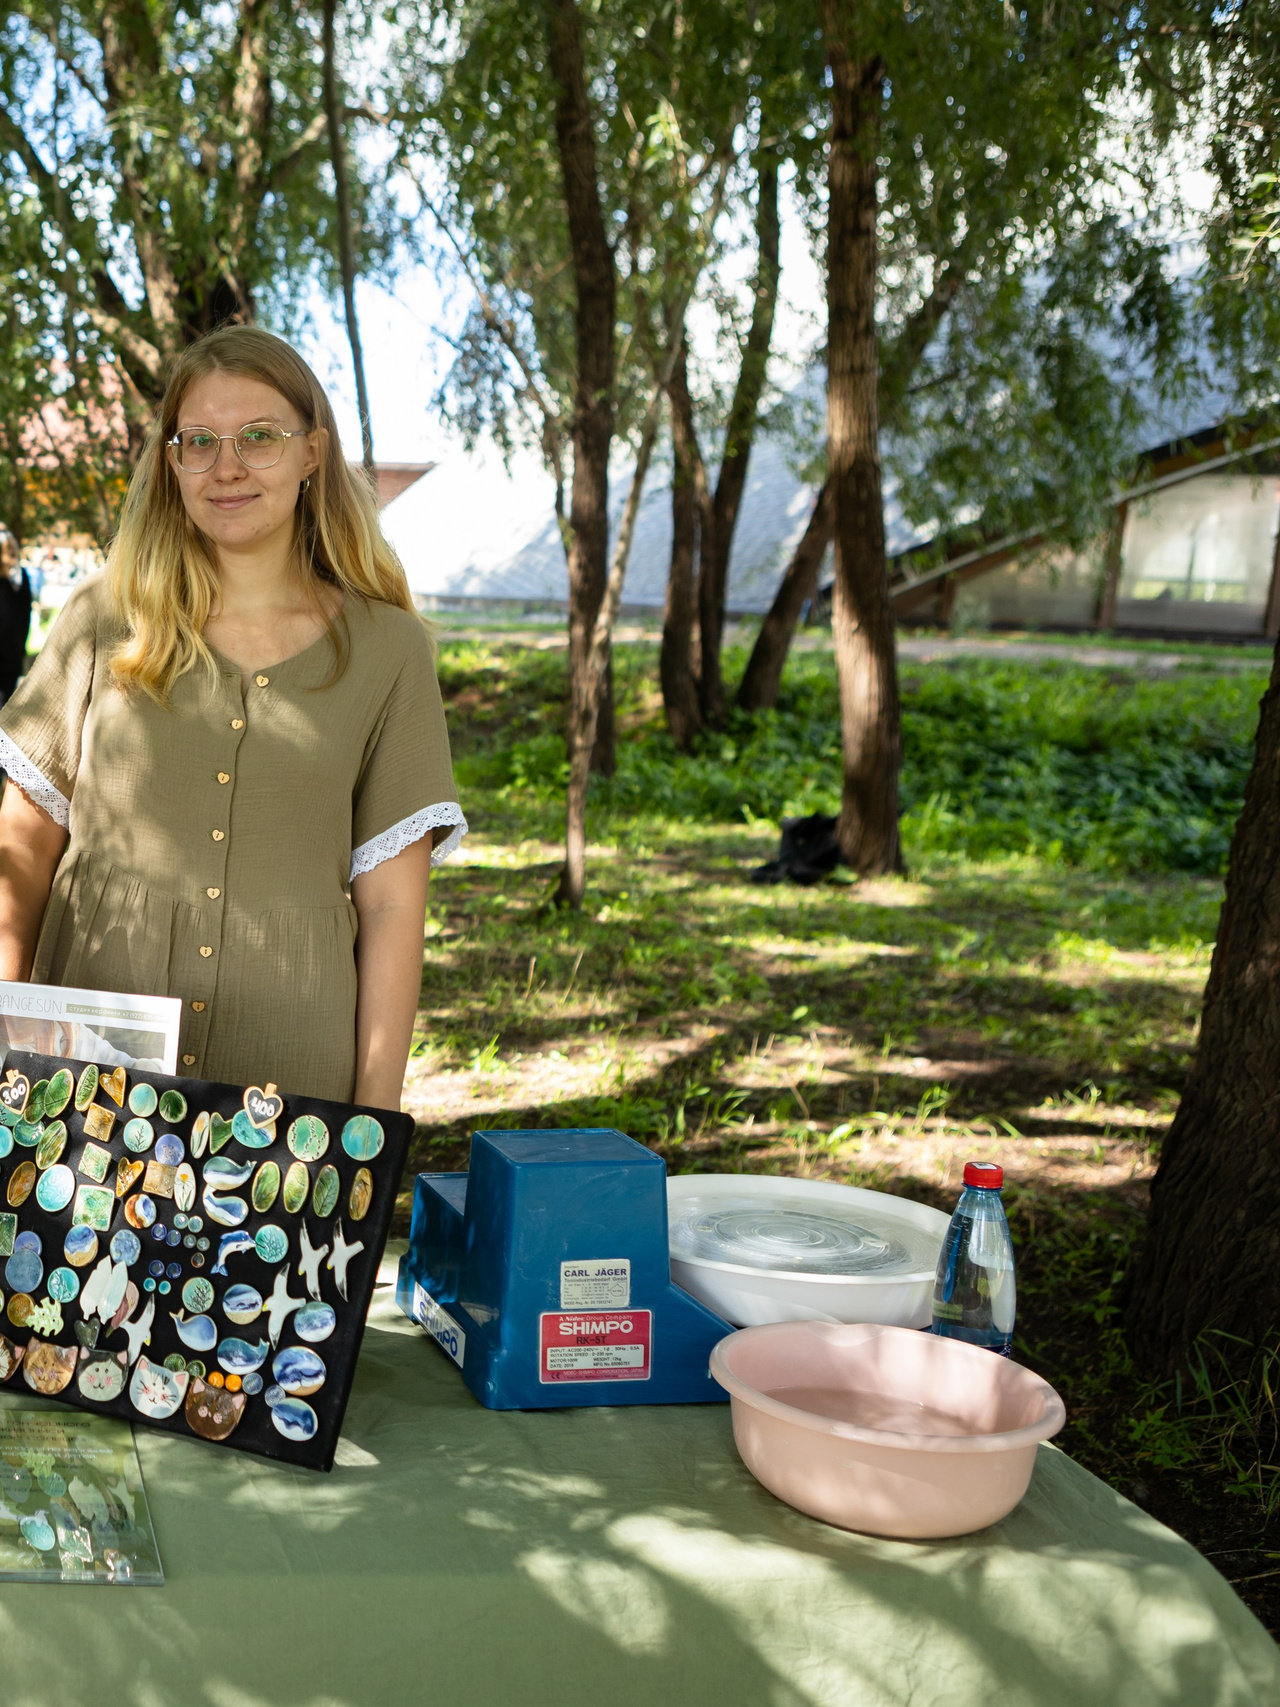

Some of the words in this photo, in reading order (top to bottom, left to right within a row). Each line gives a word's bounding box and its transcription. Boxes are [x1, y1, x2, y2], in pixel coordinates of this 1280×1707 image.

[36, 1000, 62, 1015] SUN
[2, 1082, 27, 1105] 300
[250, 1098, 276, 1117] 400
[564, 1269, 590, 1277] CARL
[595, 1267, 627, 1276] JÄGER
[559, 1320, 634, 1335] SHIMPO
[576, 1335, 607, 1345] RK-5T
